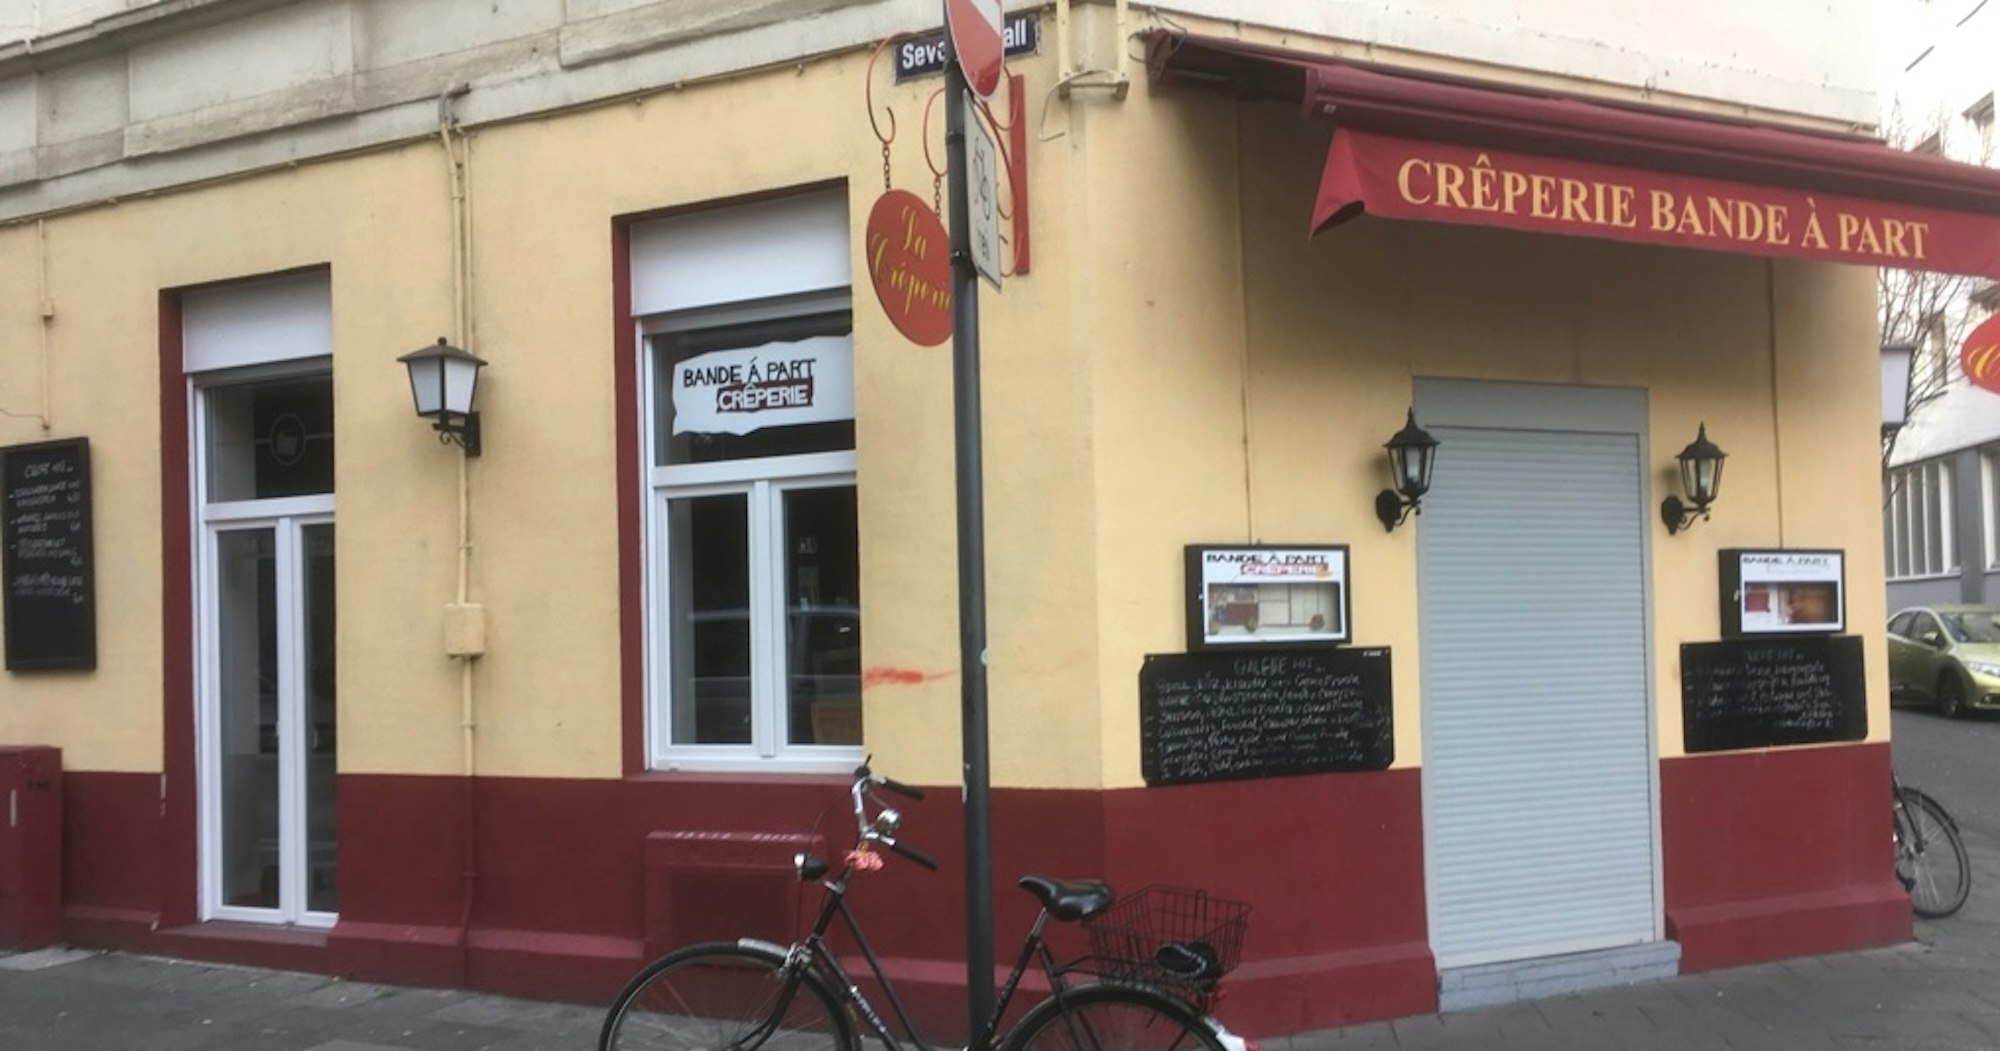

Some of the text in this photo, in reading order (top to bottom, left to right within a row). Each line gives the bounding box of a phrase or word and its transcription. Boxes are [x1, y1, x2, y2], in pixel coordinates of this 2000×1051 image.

[1398, 153, 1929, 259] CRÊPERIE BANDE À PART
[902, 205, 927, 261] La
[683, 365, 742, 387] BANDE
[766, 358, 816, 382] PART
[718, 383, 809, 411] CRÊPERIE
